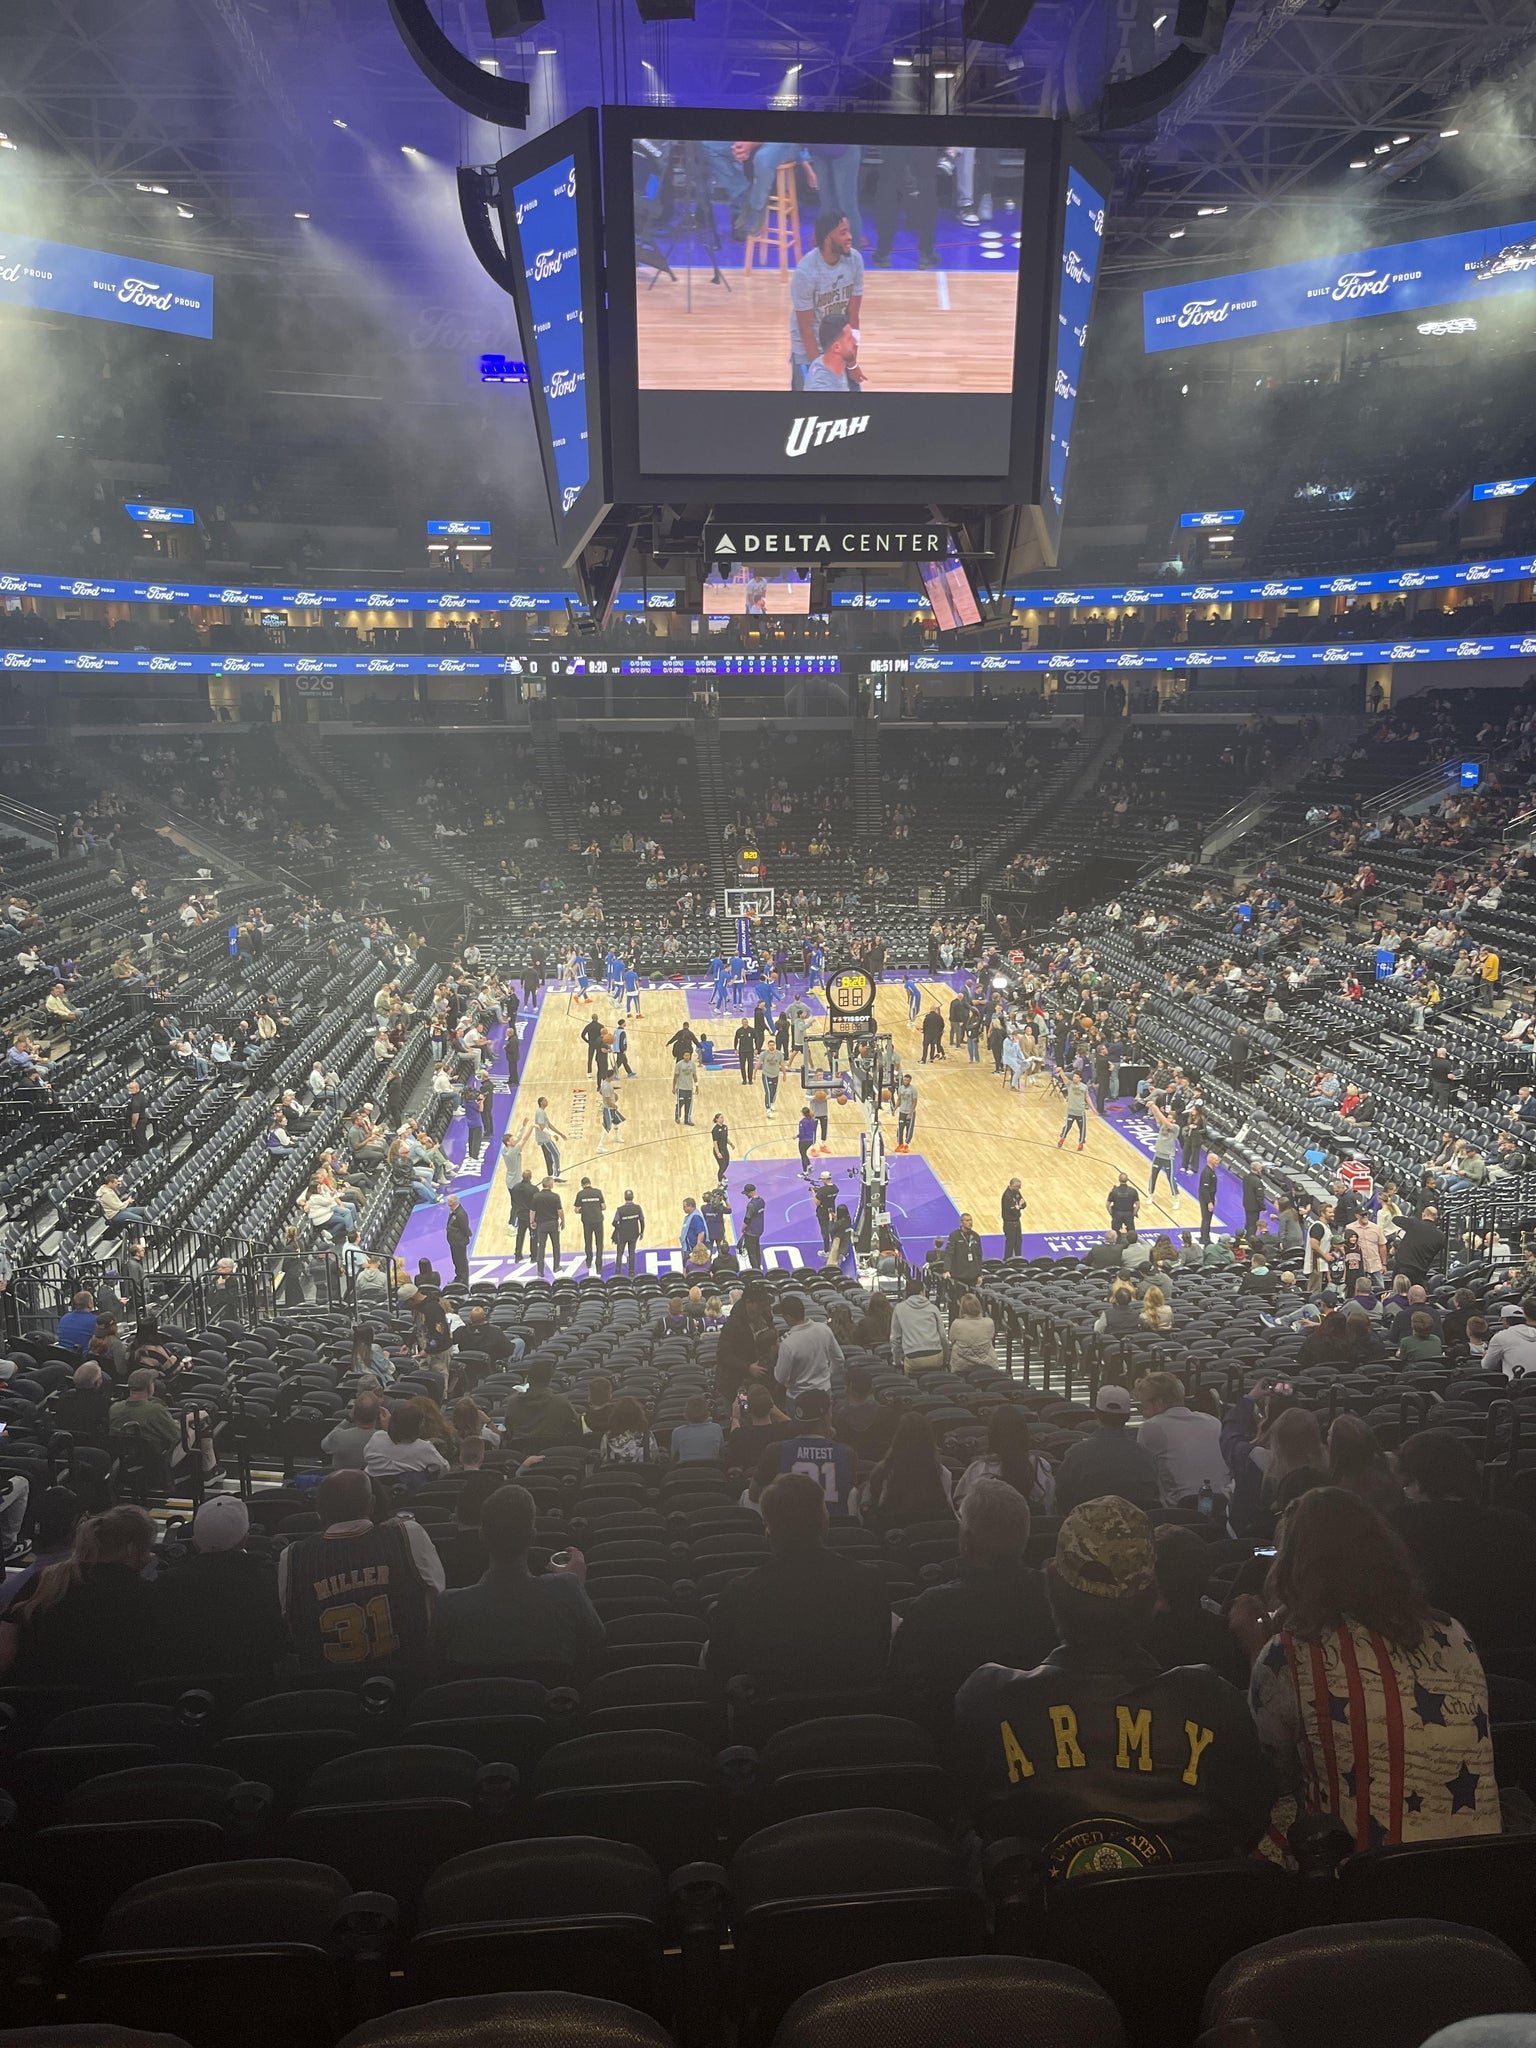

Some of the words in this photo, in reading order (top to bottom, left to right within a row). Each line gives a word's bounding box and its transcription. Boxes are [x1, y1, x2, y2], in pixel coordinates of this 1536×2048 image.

[554, 184, 567, 197] BUILT
[523, 200, 538, 212] PROUD
[534, 249, 562, 281] Ford
[562, 248, 578, 261] PROUD
[1066, 251, 1084, 283] Ford
[24, 268, 53, 280] PROUD
[1307, 287, 1330, 298] BUILT
[1332, 270, 1391, 301] Ford
[1392, 271, 1422, 283] PROUD
[94, 281, 116, 292] BUILT
[118, 279, 173, 311] Ford
[174, 298, 200, 309] PROUD
[566, 311, 578, 321] BUILT
[1156, 314, 1177, 325] BUILT
[1178, 299, 1230, 328] Ford
[1231, 300, 1257, 311] PROUD
[537, 322, 551, 333] PROUD
[550, 370, 576, 399] Ford
[1055, 370, 1070, 399] Ford
[786, 415, 871, 457] UTAH
[1493, 483, 1516, 495] Ford
[147, 508, 171, 520] Ford
[1201, 514, 1222, 524] Ford
[448, 522, 469, 533] Ford
[744, 533, 831, 552] DELTA
[842, 533, 939, 552] CENTER
[1466, 566, 1491, 580] Ford
[1331, 579, 1358, 592] Ford
[1399, 573, 1425, 586] Ford
[72, 582, 100, 596] Ford
[146, 586, 174, 600] Ford
[1192, 587, 1219, 600] Ford
[1262, 584, 1289, 596] Ford
[221, 590, 248, 603] Ford
[295, 592, 322, 605] Ford
[368, 594, 395, 606] Ford
[439, 595, 466, 607] Ford
[510, 595, 536, 607] Ford
[648, 595, 675, 607] Ford
[1054, 592, 1080, 604] Ford
[1123, 590, 1150, 602] Ford
[1323, 648, 1349, 661] Ford
[1390, 646, 1416, 658] Ford
[1457, 642, 1481, 656] Ford
[4, 654, 32, 667] Ford
[76, 656, 104, 668] Ford
[982, 657, 1007, 668] Ford
[1049, 656, 1075, 667] Ford
[1118, 654, 1144, 666] Ford
[1186, 653, 1213, 664] Ford
[1255, 651, 1282, 663] Ford
[150, 657, 177, 670] Ford
[223, 658, 250, 670] Ford
[296, 659, 323, 671] Ford
[368, 660, 395, 671] Ford
[439, 660, 466, 671] Ford
[530, 661, 538, 673] 0
[552, 661, 560, 673] 0
[588, 661, 607, 673] 8:20
[871, 660, 892, 672] 06:51
[895, 660, 908, 672] PM
[914, 658, 940, 669] Ford
[296, 675, 334, 690] G2G
[1064, 670, 1100, 684] G2G
[572, 1094, 587, 1114] DELTA
[797, 1446, 834, 1460] ARTEST
[313, 1565, 390, 1601] MILLER
[319, 1593, 400, 1664] 31
[1000, 1703, 1215, 1787] ARMY
[1050, 1831, 1105, 1863] UNITED
